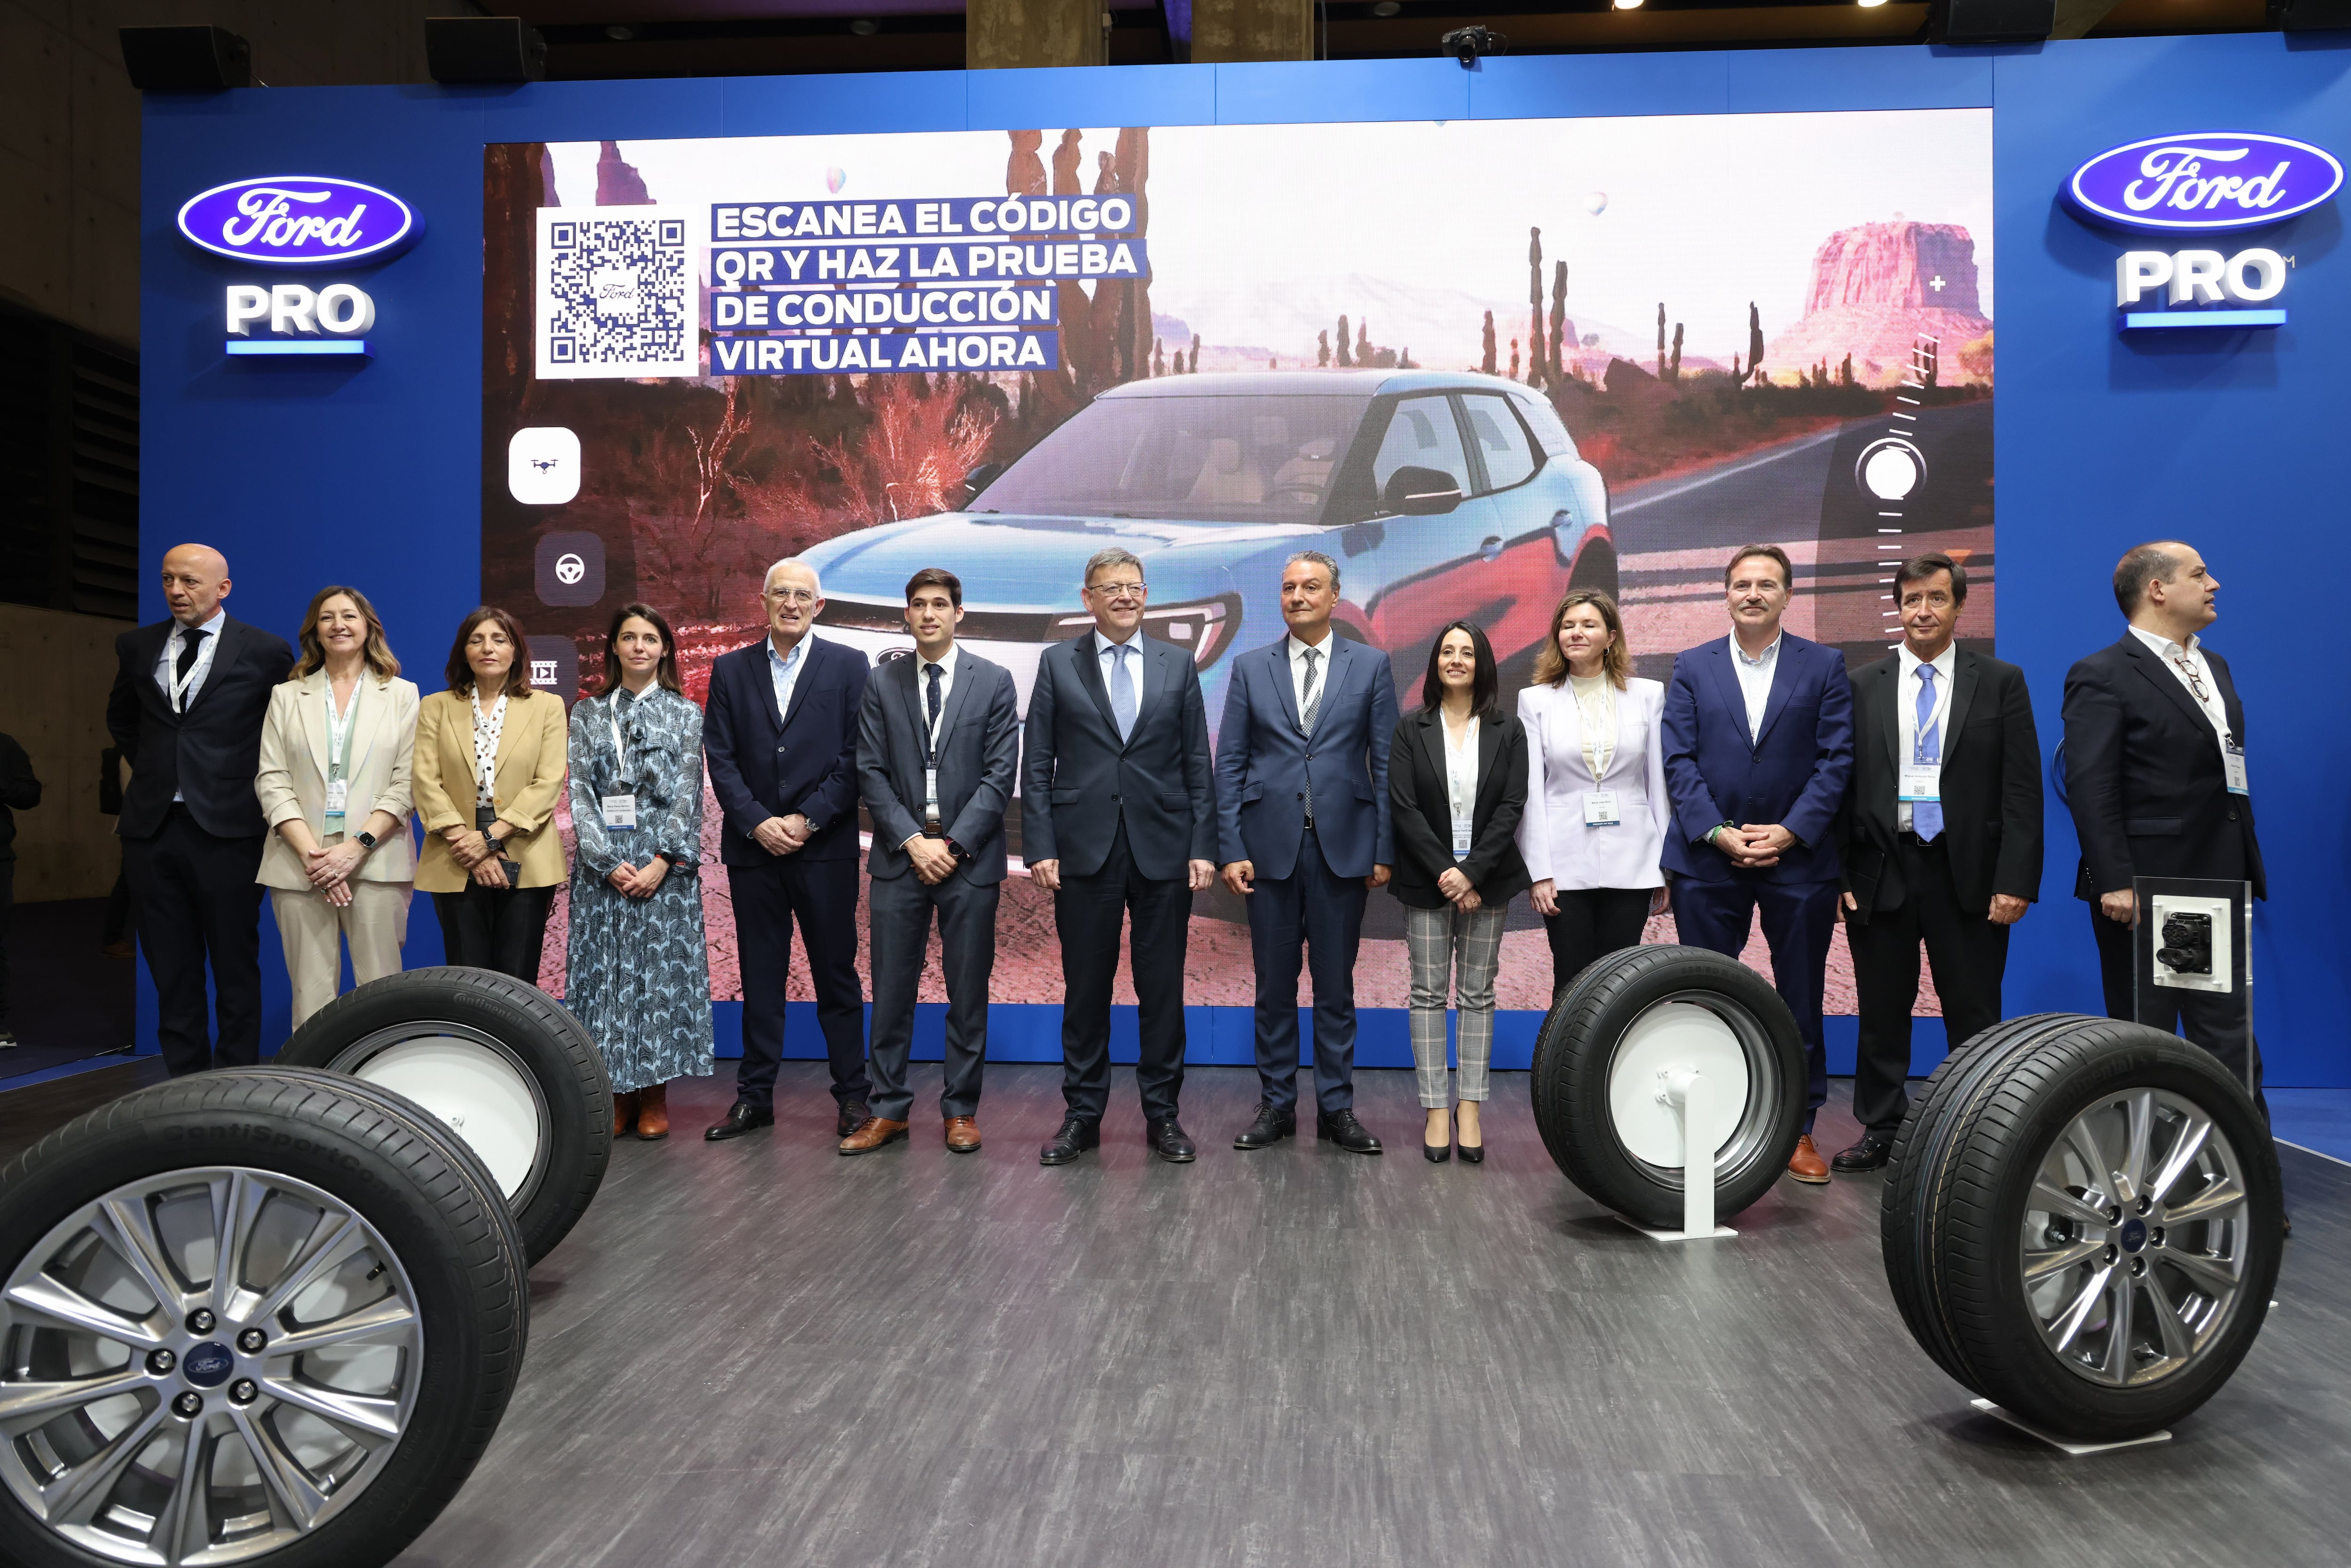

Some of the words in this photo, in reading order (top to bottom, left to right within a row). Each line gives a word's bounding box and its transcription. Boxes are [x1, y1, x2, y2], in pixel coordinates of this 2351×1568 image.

[2123, 146, 2291, 211] Ford
[222, 187, 367, 247] Ford
[717, 205, 907, 238] ESCANEA
[916, 203, 962, 233] EL
[970, 192, 1131, 233] CÓDIGO
[716, 249, 774, 287] QR
[781, 250, 810, 280] Y
[819, 248, 900, 279] HAZ
[909, 247, 960, 277] LA
[969, 243, 1138, 276] PRUEBA
[2118, 248, 2286, 306] PRO
[227, 283, 374, 336] PRO
[600, 284, 635, 299] Ford
[717, 295, 768, 326] DE
[777, 287, 1050, 325] CONDUCCIÓN
[715, 338, 892, 370] VIRTUAL
[898, 335, 1046, 368] AHORA
[453, 992, 523, 1026] Continental
[196, 1360, 220, 1372] Ford
